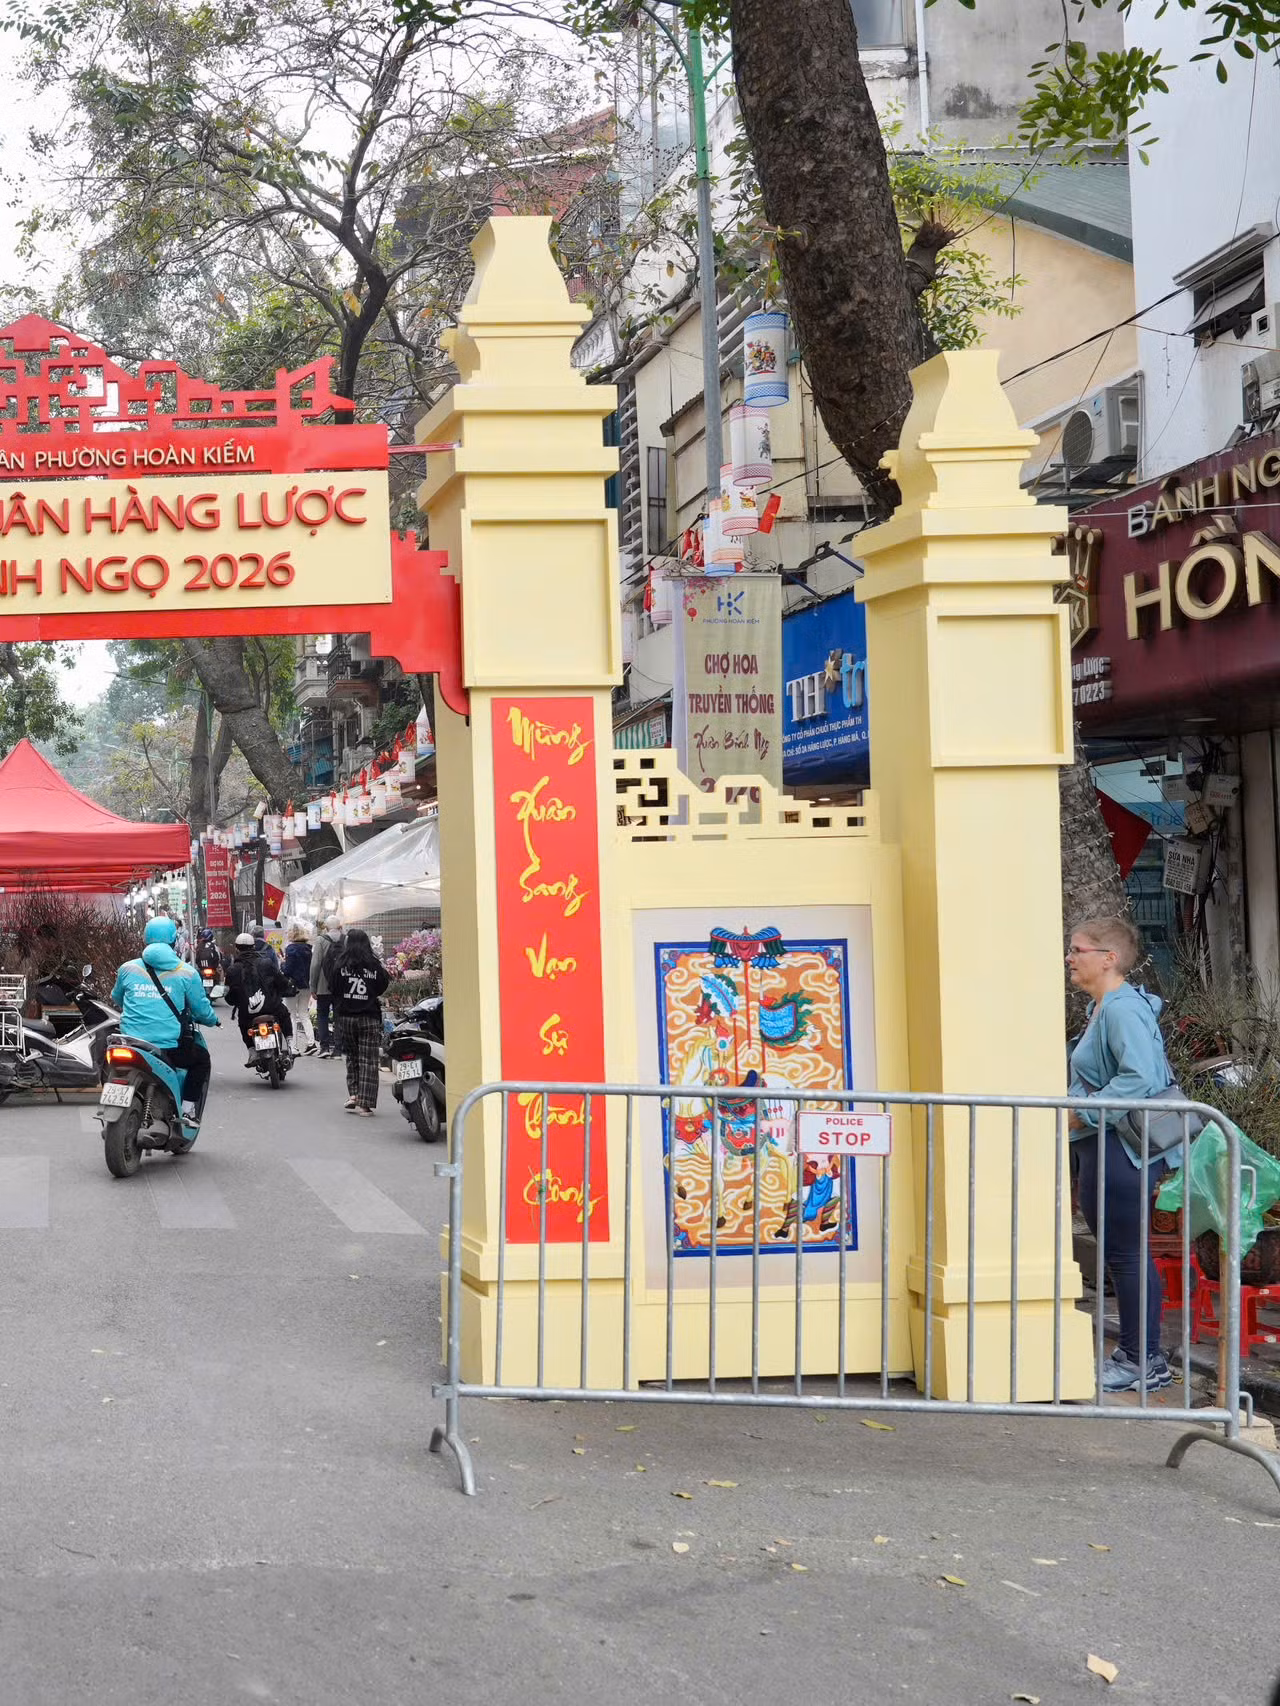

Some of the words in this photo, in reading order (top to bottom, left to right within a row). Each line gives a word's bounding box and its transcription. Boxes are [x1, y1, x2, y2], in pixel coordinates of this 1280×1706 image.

[35, 447, 127, 469] PHƯỜNG
[133, 447, 195, 467] HOÀN
[203, 440, 255, 465] KIẾM
[84, 484, 220, 533] HÀNG
[237, 485, 367, 537] LƯỢC
[1128, 476, 1220, 539] BÁNH
[60, 554, 170, 598] NGỌ
[183, 551, 295, 591] 2026
[705, 651, 730, 679] CHỢ
[733, 654, 758, 674] HOA
[688, 684, 732, 714] TRUYỀN
[735, 685, 775, 714] THỐNG
[786, 670, 827, 722] TH
[506, 706, 595, 766] Mừng
[510, 775, 577, 848] Xuân
[210, 892, 227, 900] 2026
[520, 865, 591, 917] Sang
[525, 932, 577, 980] Vạn
[348, 977, 367, 995] 76
[539, 1013, 569, 1056] Sự
[818, 1131, 871, 1147] STOP
[825, 1117, 864, 1126] POLICE
